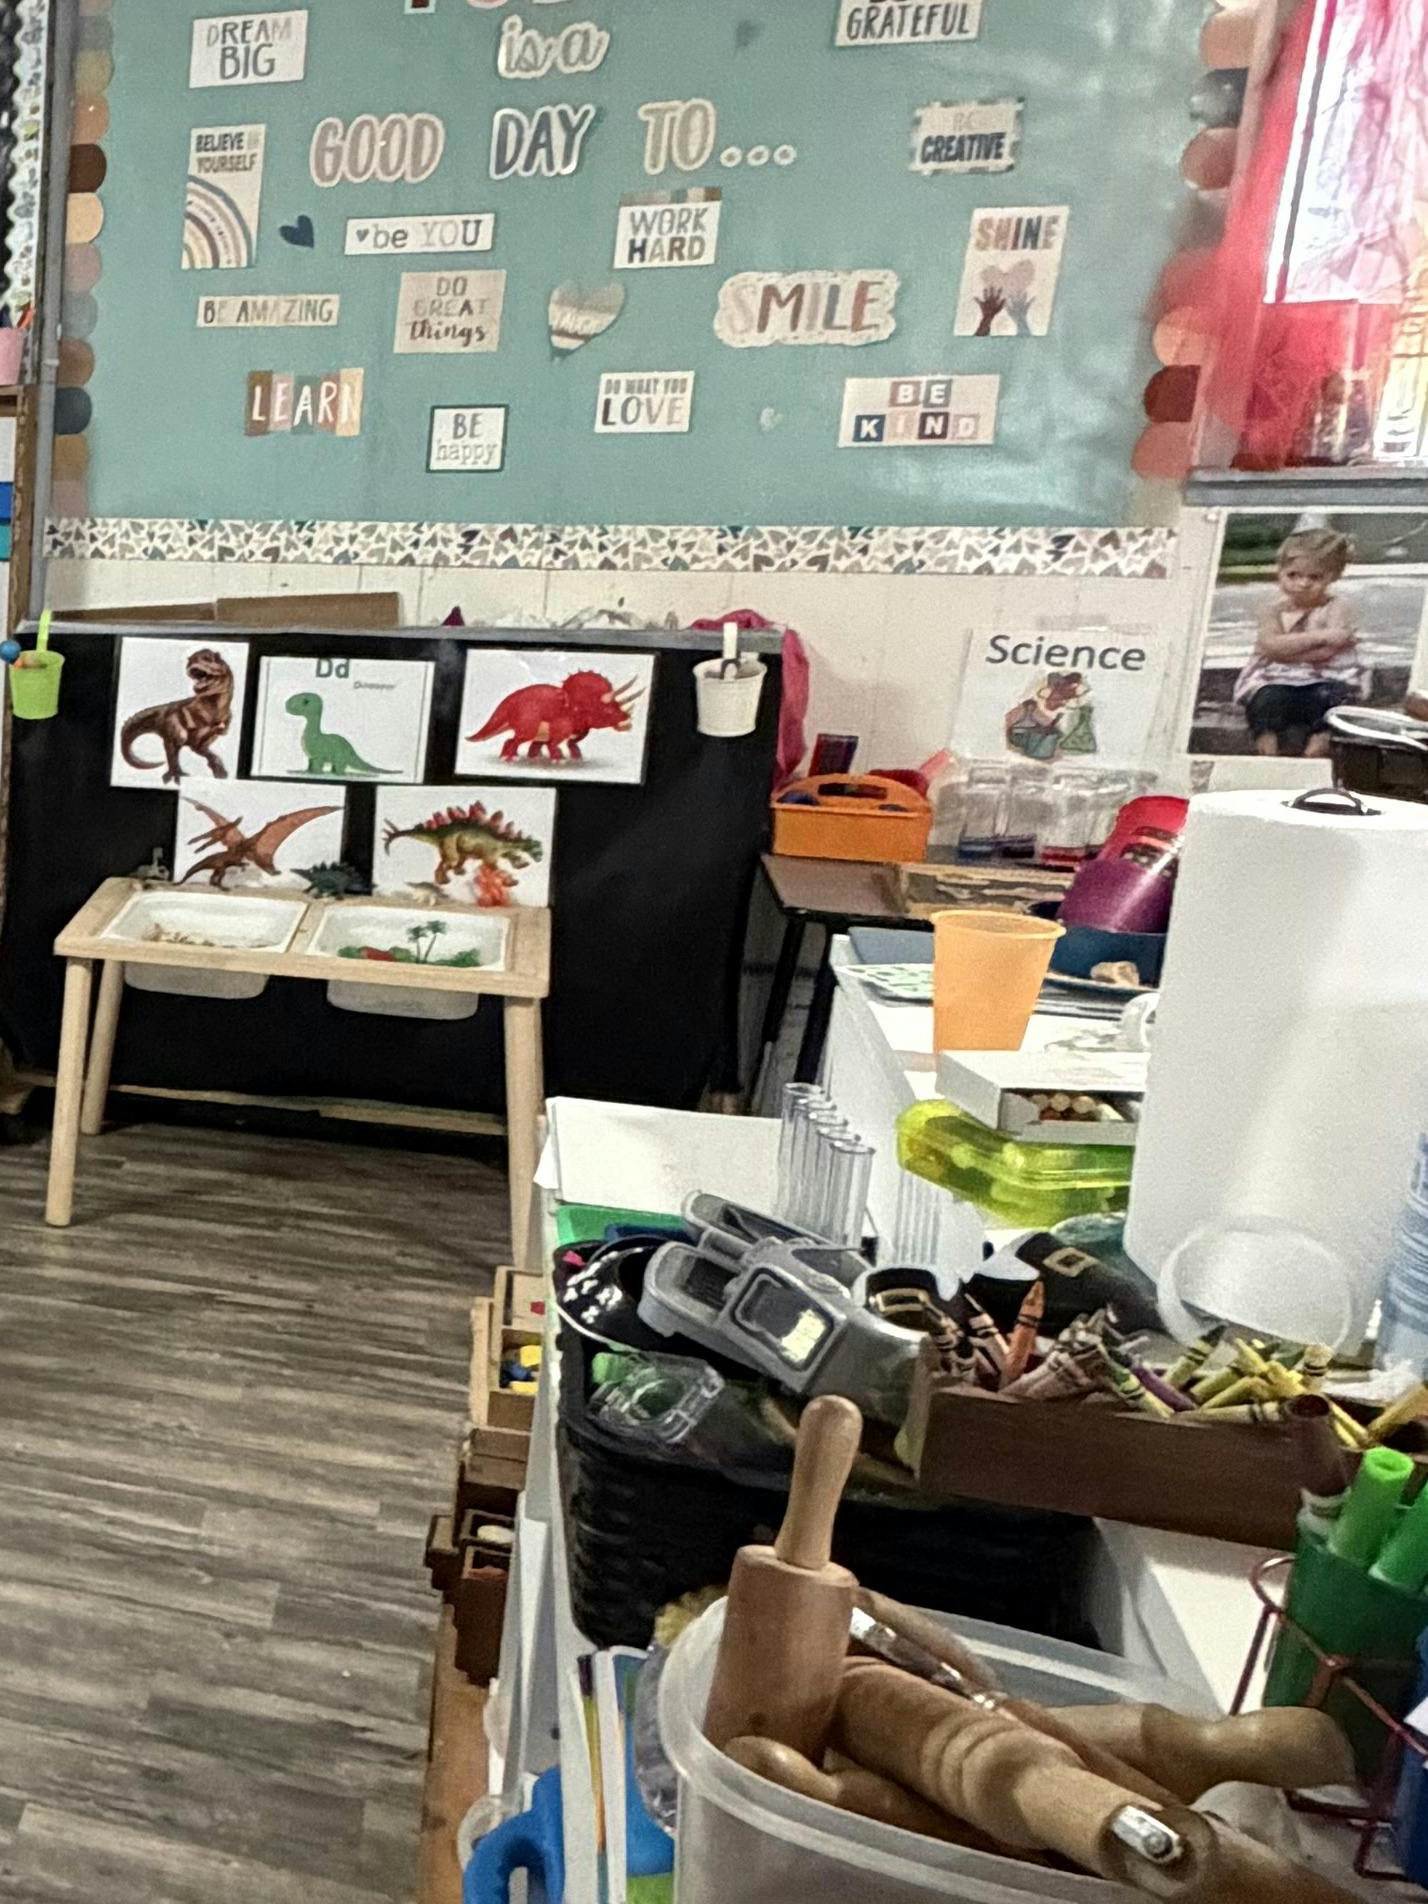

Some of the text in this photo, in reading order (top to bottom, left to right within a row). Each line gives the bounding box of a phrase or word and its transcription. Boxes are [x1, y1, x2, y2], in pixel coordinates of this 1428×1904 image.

[206, 17, 293, 47] DREAM
[846, 2, 970, 40] GRATEFUL
[220, 44, 276, 80] BIG
[498, 16, 610, 78] is a
[195, 132, 245, 153] BELIEVE
[310, 113, 444, 187] GOOD
[490, 104, 595, 180] DAY
[920, 132, 1006, 163] CREATIVE
[197, 153, 258, 174] YOURSELF
[373, 216, 483, 249] be YOU
[629, 207, 708, 237] WORK
[976, 215, 1060, 251] SHINE
[627, 236, 706, 264] HARD
[436, 277, 468, 297] DO
[203, 298, 334, 324] BE AMAZING
[413, 297, 489, 318] GREAT
[720, 280, 884, 334] SMILE
[409, 319, 487, 347] things
[250, 380, 357, 427] LEARN
[893, 381, 949, 407] BE
[452, 413, 482, 440] BE
[601, 396, 686, 427] LOVE
[856, 413, 978, 441] KIND
[434, 440, 498, 465] happy
[985, 634, 1146, 671] Science
[315, 657, 350, 679] Dd
